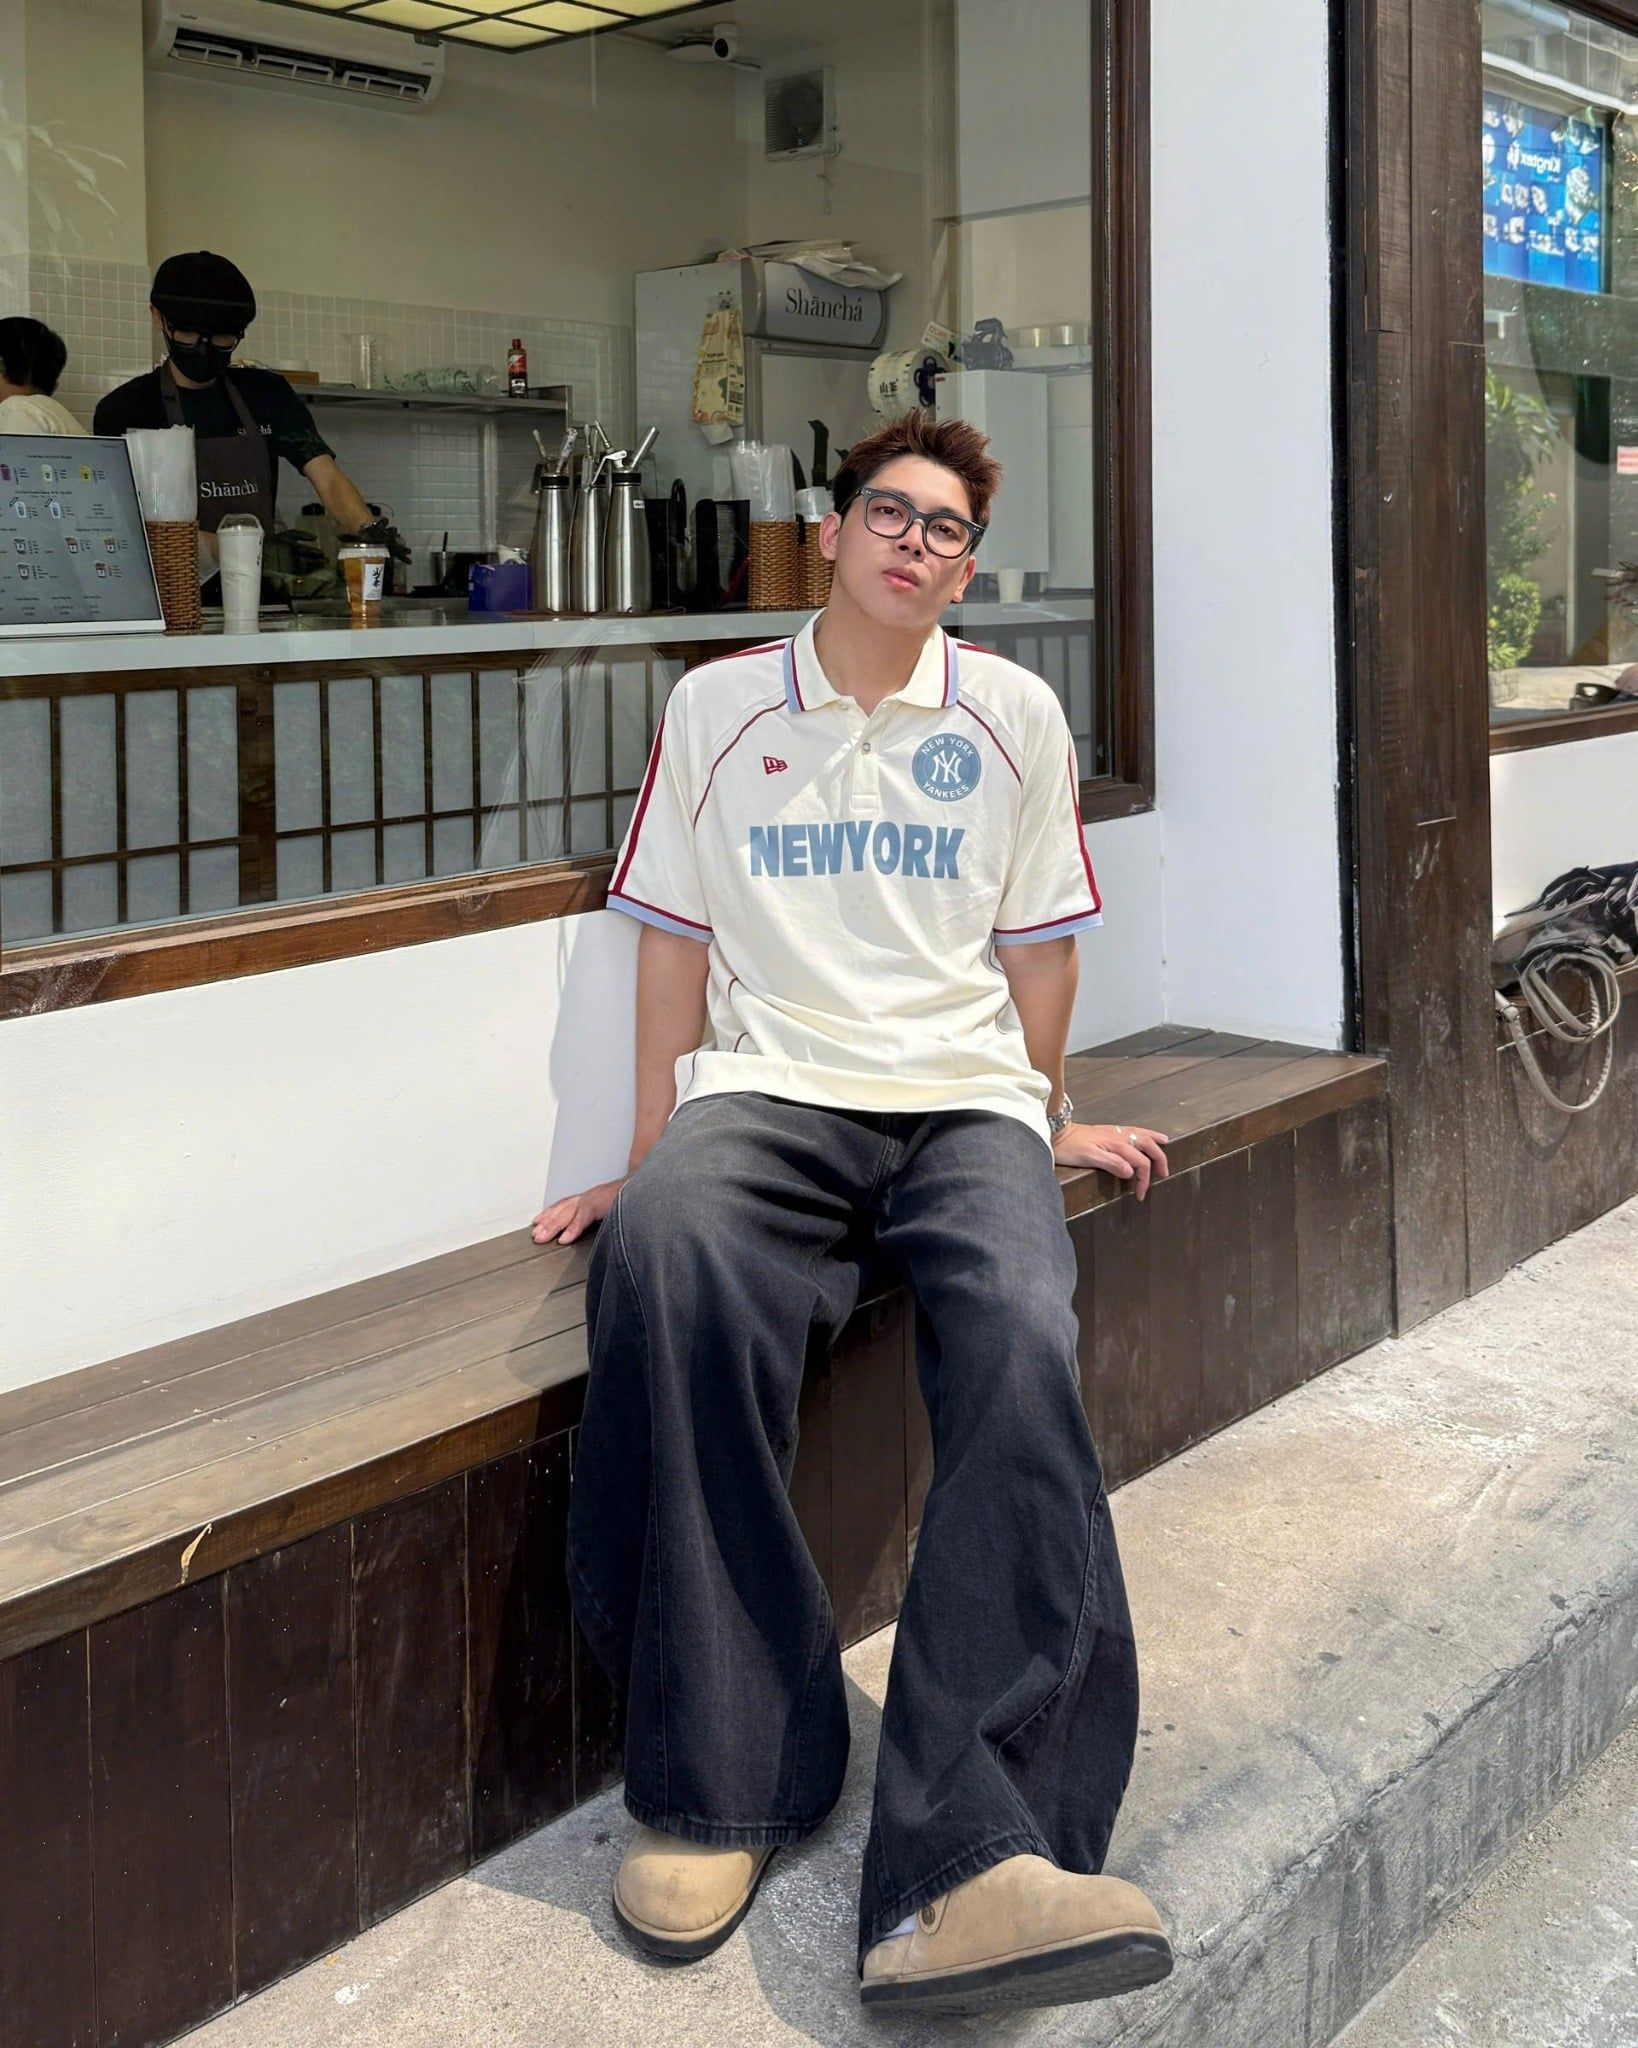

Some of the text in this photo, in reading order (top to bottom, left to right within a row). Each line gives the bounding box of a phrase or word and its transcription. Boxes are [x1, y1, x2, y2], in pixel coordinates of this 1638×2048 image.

[785, 287, 863, 322] Shānchá
[921, 737, 975, 757] NEW YORK
[930, 749, 962, 784] NY
[923, 781, 970, 799] YANKEES
